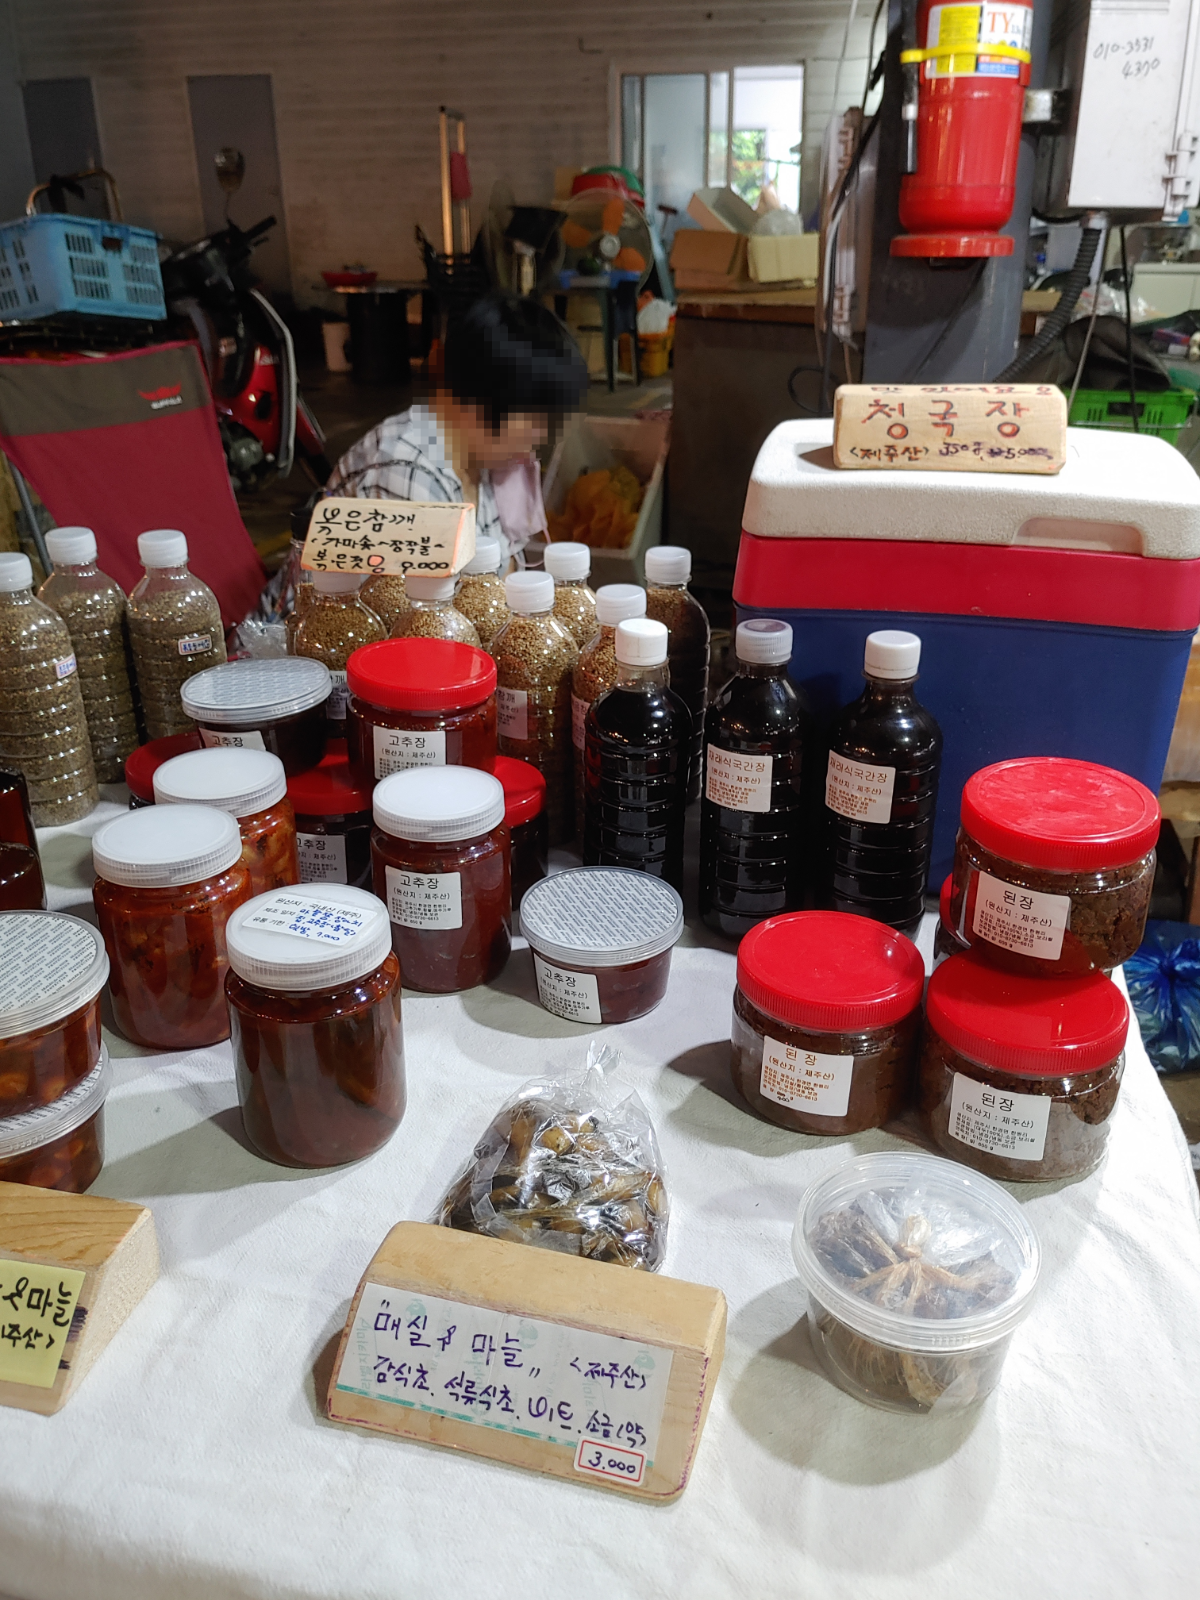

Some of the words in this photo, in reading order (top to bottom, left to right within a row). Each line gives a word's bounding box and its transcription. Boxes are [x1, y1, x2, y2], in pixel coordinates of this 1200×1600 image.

[987, 12, 1015, 34] TY
[212, 735, 243, 747] 고추장
[389, 734, 425, 748] 고추장
[401, 874, 439, 889] 고추장
[1003, 890, 1034, 910] 된장
[1021, 914, 1052, 927] 제주산)
[544, 967, 576, 987] 고추장
[805, 1069, 834, 1080] 제주산)
[981, 1092, 1014, 1112] 된장
[962, 1102, 991, 1120] (원산지
[1002, 1116, 1034, 1128] 제주산)
[1, 1323, 55, 1350] 주산>
[588, 1451, 636, 1474] 3.000
